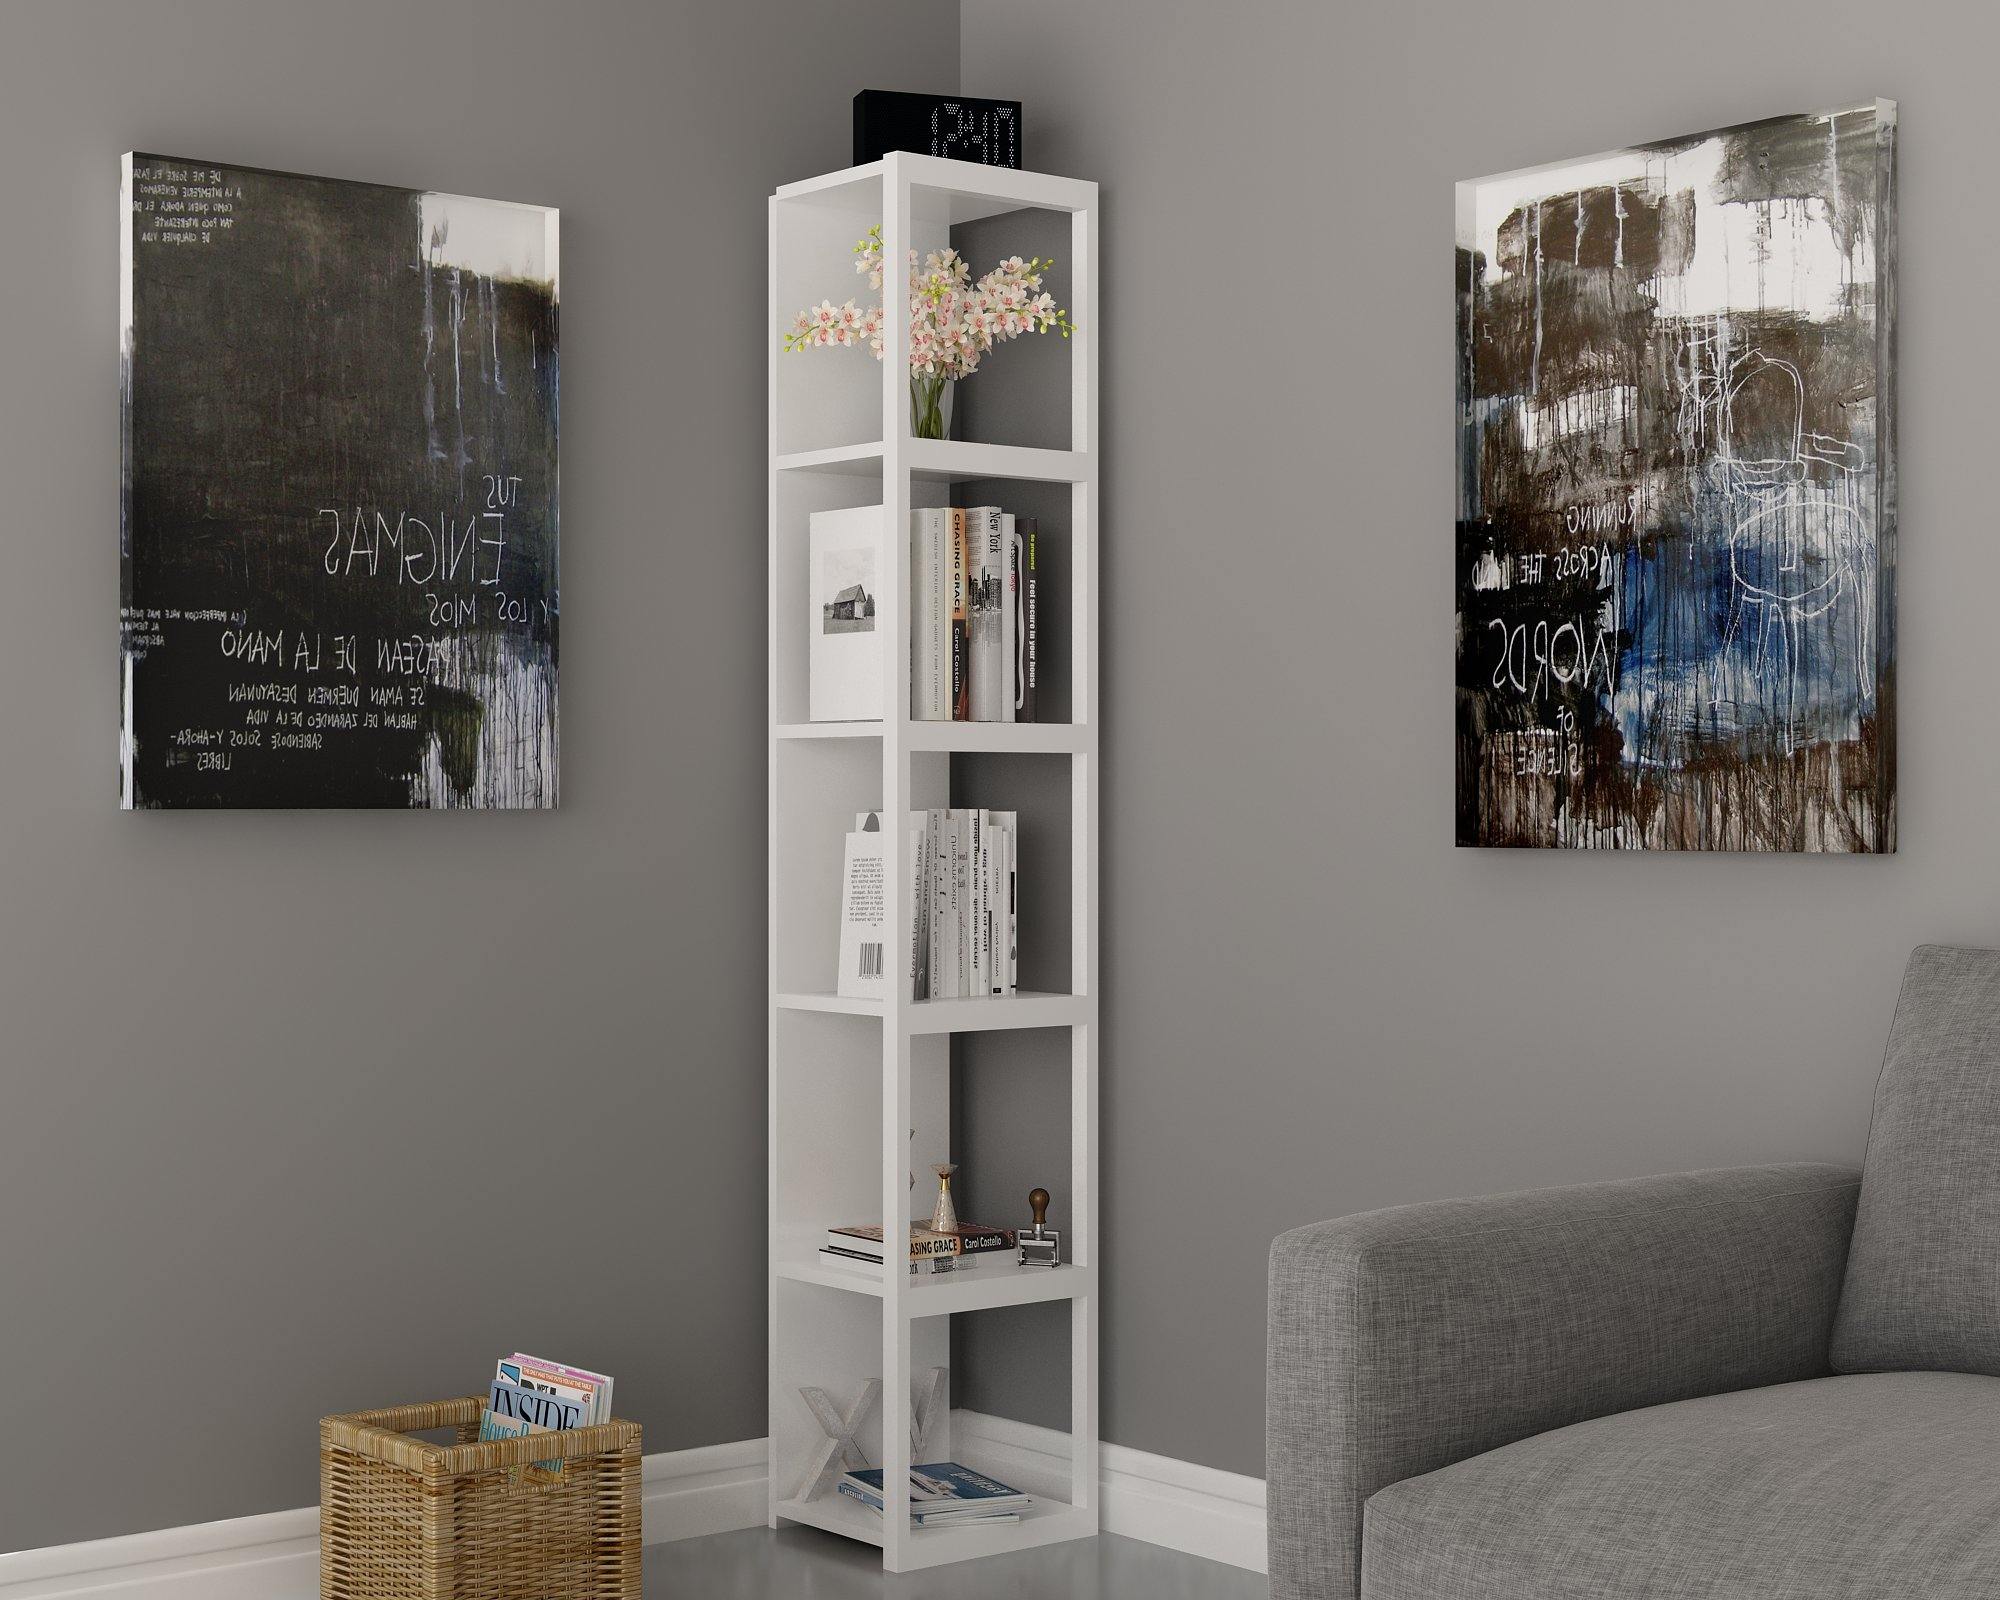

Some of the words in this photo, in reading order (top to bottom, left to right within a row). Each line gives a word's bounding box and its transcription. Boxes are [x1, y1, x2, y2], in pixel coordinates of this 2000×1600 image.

[990, 512, 1000, 534] New
[990, 534, 1001, 554] York
[1030, 630, 1035, 639] in
[910, 1241, 932, 1255] ASING
[934, 1238, 957, 1253] GRACE
[965, 1237, 979, 1249] Carol
[980, 1235, 1002, 1248] Costello
[494, 1387, 579, 1430] INSIDE
